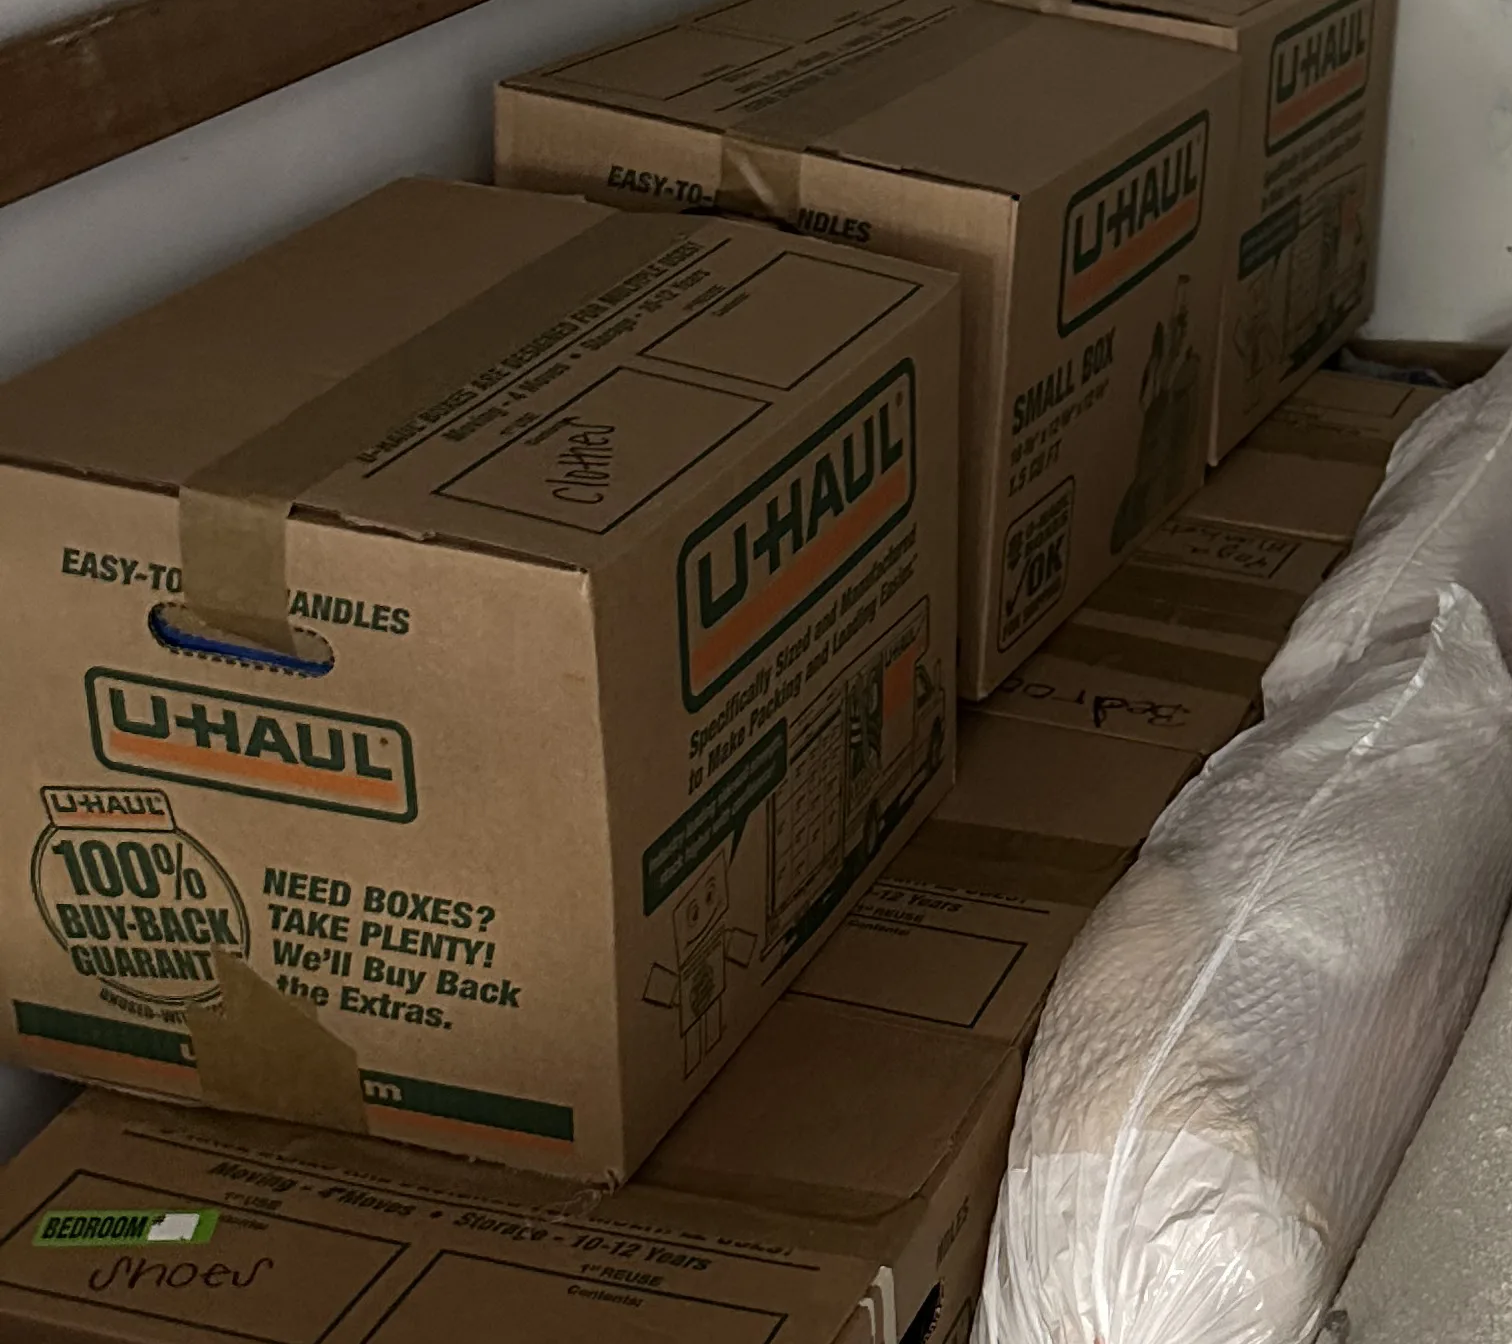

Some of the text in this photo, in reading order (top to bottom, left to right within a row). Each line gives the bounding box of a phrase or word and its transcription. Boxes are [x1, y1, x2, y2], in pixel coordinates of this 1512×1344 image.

[1276, 6, 1366, 104] U-HAUL
[606, 164, 873, 244] EASY-TO- NDLES
[1071, 139, 1202, 276] U-HAUL
[1011, 358, 1076, 436] SMALL
[1080, 324, 1117, 388] BOX
[697, 400, 906, 630] U-HAUL
[61, 546, 411, 636] EASY-TO ANDLES
[689, 666, 773, 760] Specifically
[775, 624, 812, 678] Sized
[813, 600, 838, 642] and
[1001, 676, 1192, 730] Bedroo
[107, 687, 396, 782] U-HAUL
[687, 766, 704, 796] to
[708, 725, 746, 778] Make
[750, 670, 804, 737] Packing
[49, 792, 166, 817] U-HAUL
[52, 839, 208, 901] 100%
[262, 866, 497, 934] NEED BOXES?
[55, 902, 241, 946] BUY-BACK
[267, 903, 497, 969] TAKE PLENTY!
[70, 943, 222, 982] GUARANT
[271, 939, 521, 1009] We'll Buy Back
[276, 973, 454, 1032] the Extras.
[41, 1214, 150, 1240] BEDROOM
[208, 1161, 299, 1193] Moving
[571, 1233, 643, 1260] 10-12
[643, 1245, 713, 1274] Years
